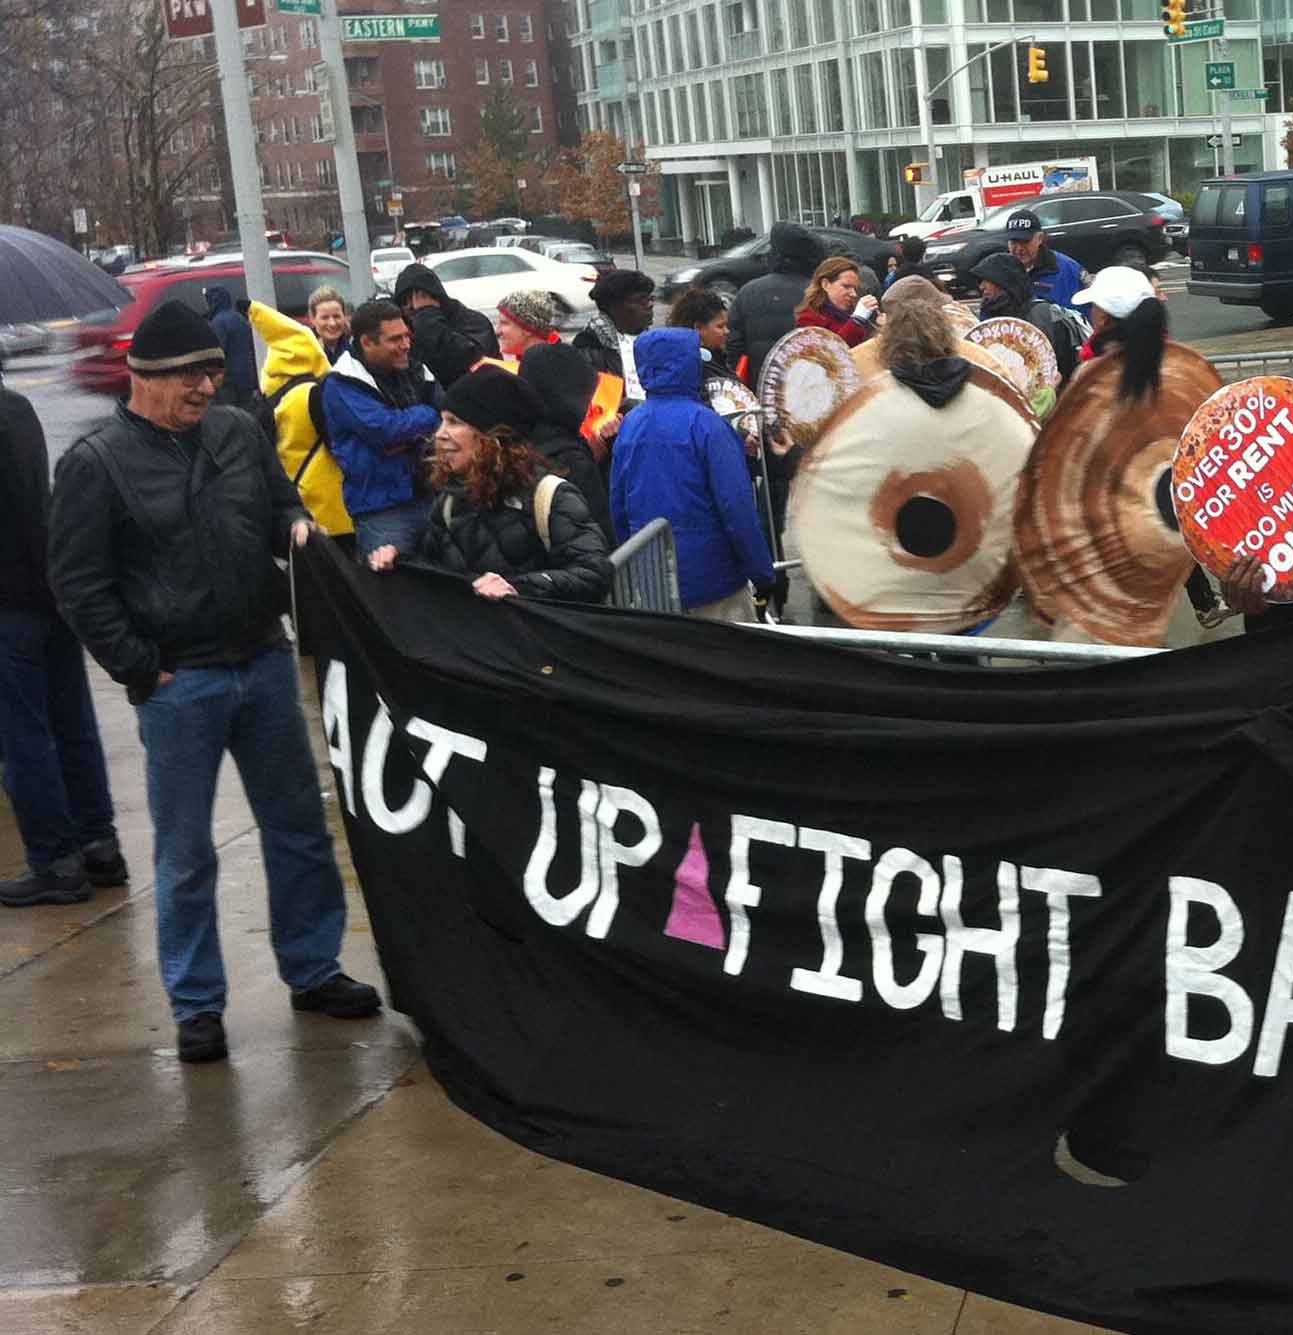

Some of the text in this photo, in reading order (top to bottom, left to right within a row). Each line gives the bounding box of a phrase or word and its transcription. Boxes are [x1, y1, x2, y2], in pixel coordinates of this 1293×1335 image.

[171, 0, 208, 20] PKW
[344, 19, 405, 37] EASTERN
[1177, 387, 1277, 502] OVER 30%
[1194, 484, 1237, 531] FOR
[1233, 515, 1277, 559] TOO
[322, 660, 487, 857] ACT
[524, 767, 662, 939] UP
[724, 815, 1101, 1040] FIGHT
